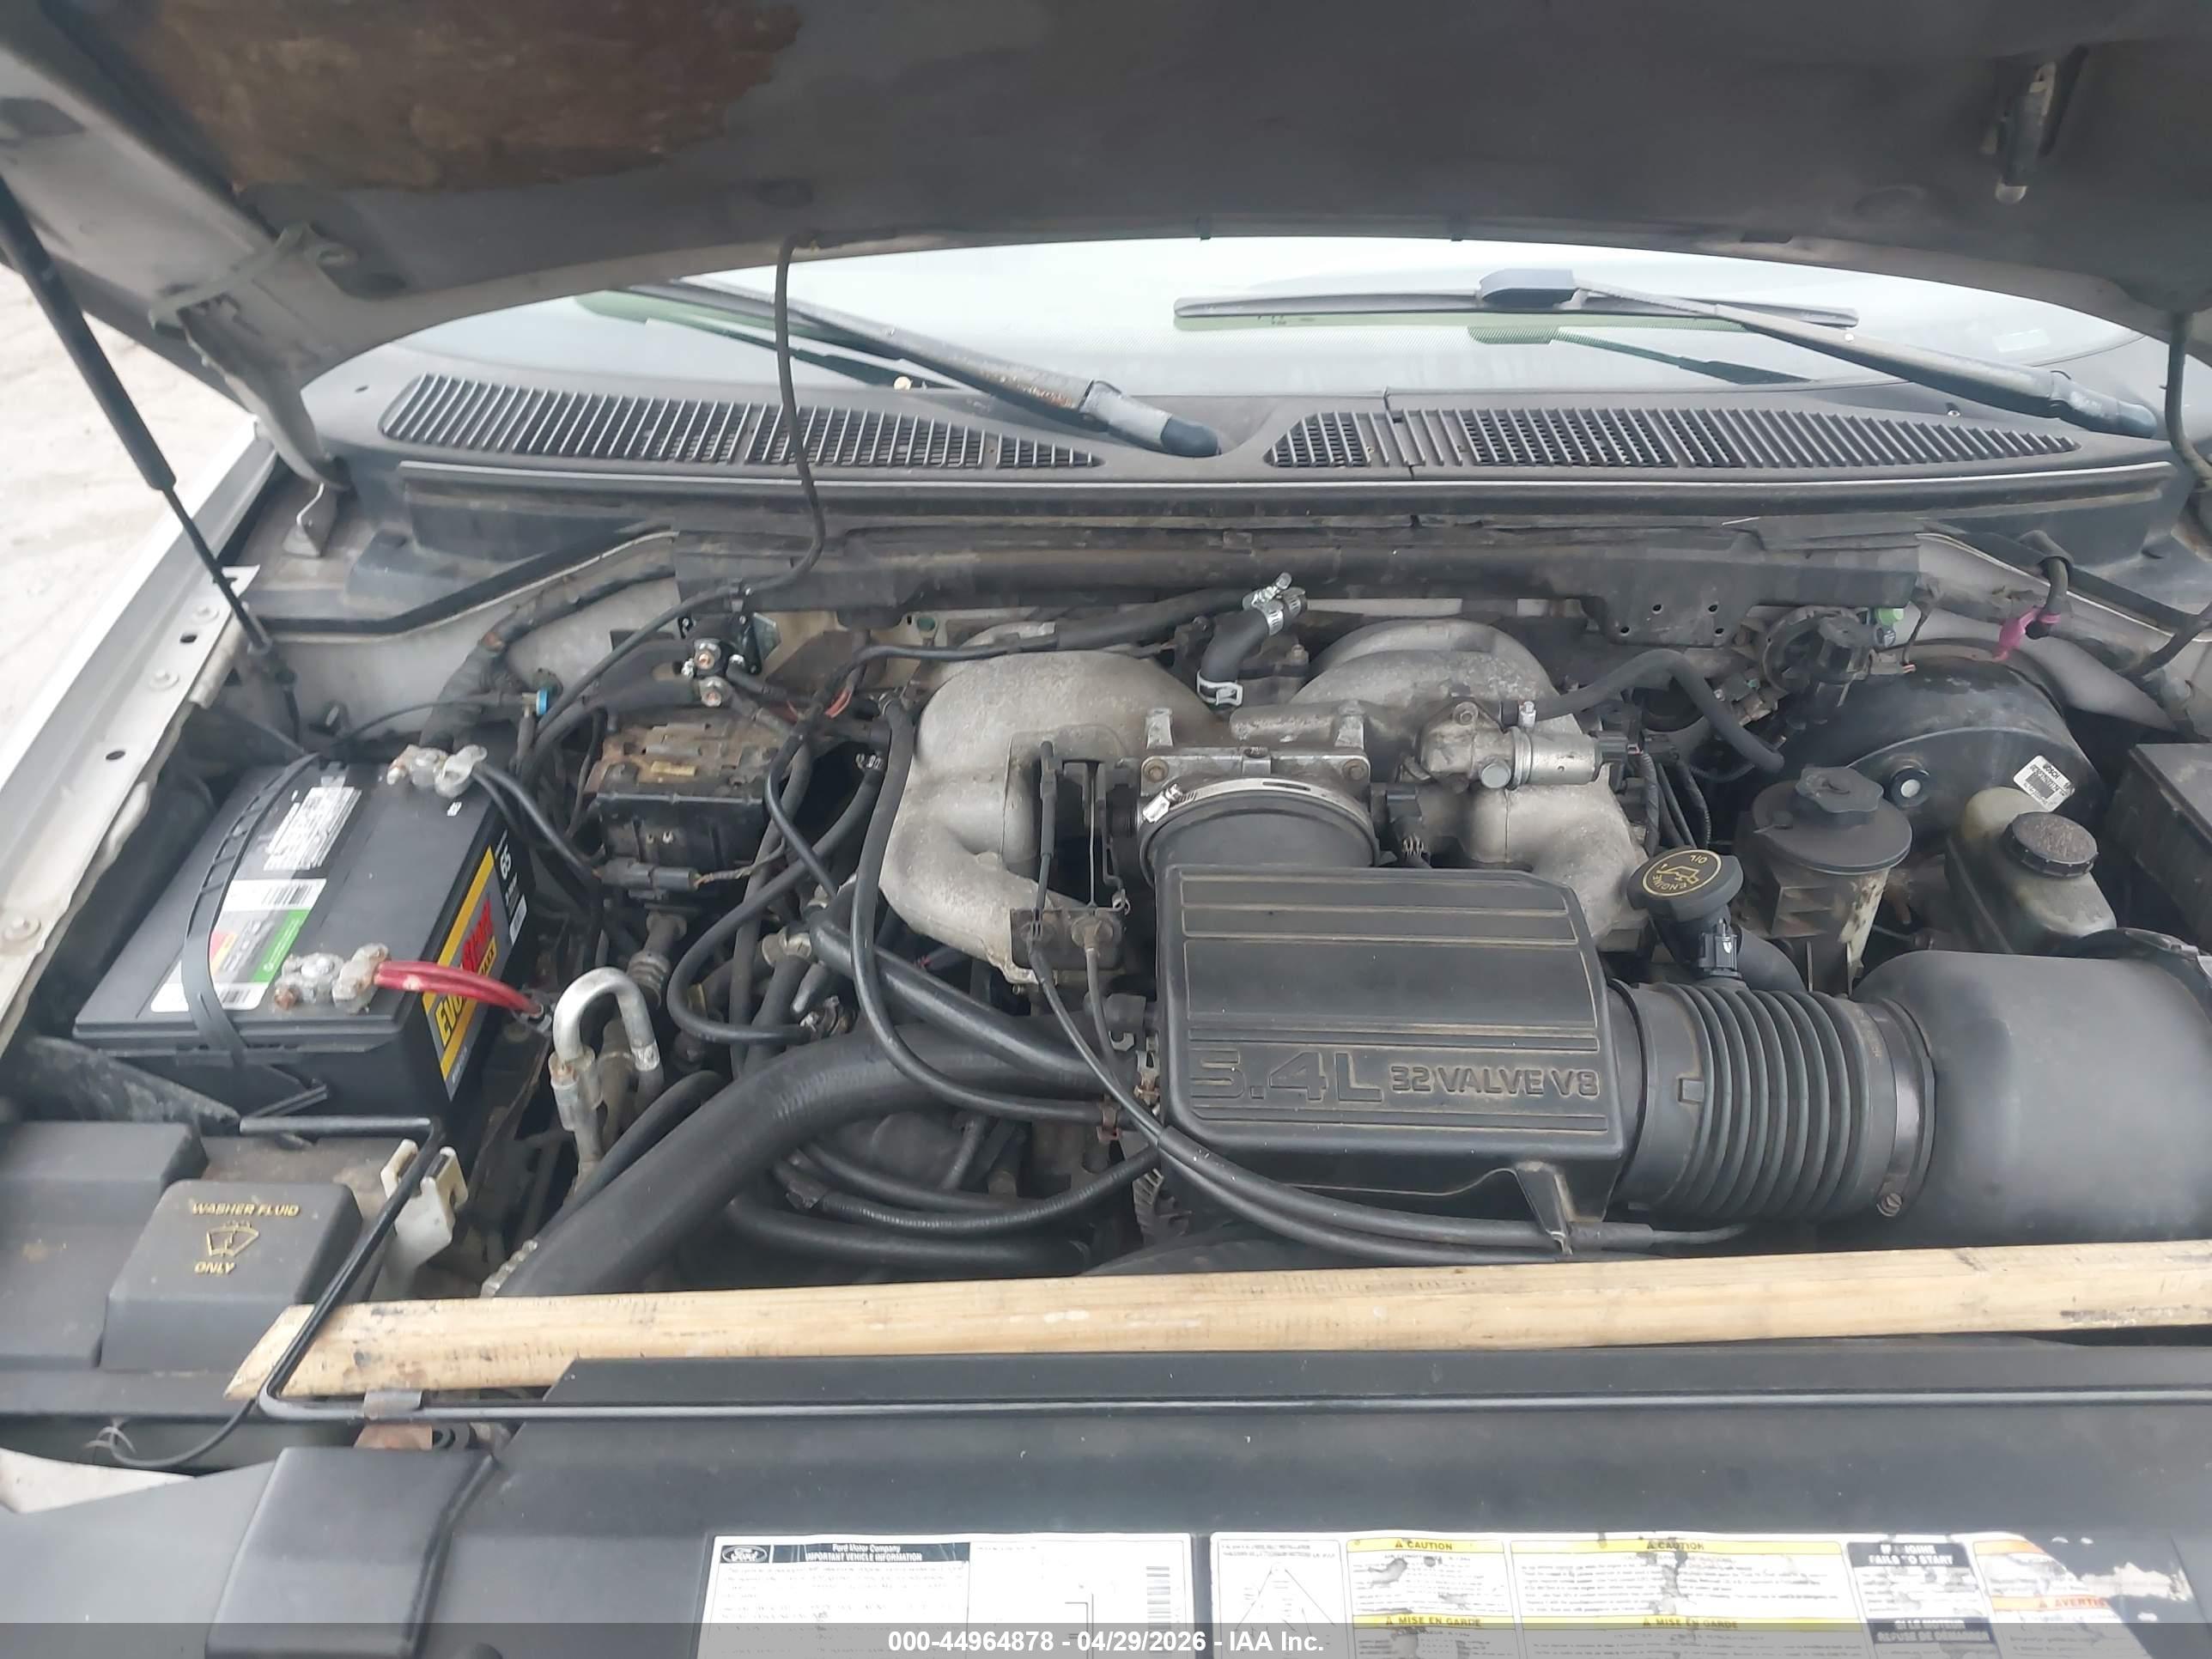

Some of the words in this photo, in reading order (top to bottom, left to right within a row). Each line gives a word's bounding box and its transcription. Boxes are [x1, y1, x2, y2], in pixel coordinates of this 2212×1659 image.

[500, 844, 512, 880] 65
[1690, 854, 1708, 864] OIL
[1653, 874, 1687, 890] ENGINE
[1189, 1048, 1385, 1103] 5.4L
[1551, 1067, 1601, 1097] V8
[191, 1202, 255, 1216] WASHER
[257, 1203, 300, 1217] FLUID
[194, 1260, 236, 1275] ONLY
[1407, 1540, 1453, 1551] CAUTION
[1657, 1541, 1705, 1551] CAUTION
[805, 1553, 845, 1562] IMPORTANT
[846, 1553, 874, 1562] VEHICLE
[875, 1553, 922, 1562] INFORMATION
[1918, 1554, 1954, 1565] START
[1399, 1616, 1425, 1626] MISE
[1429, 1616, 1443, 1626] EN
[1446, 1618, 1481, 1627] GARDE
[1656, 1617, 1681, 1626] MISE
[1703, 1619, 1739, 1629] GARDE
